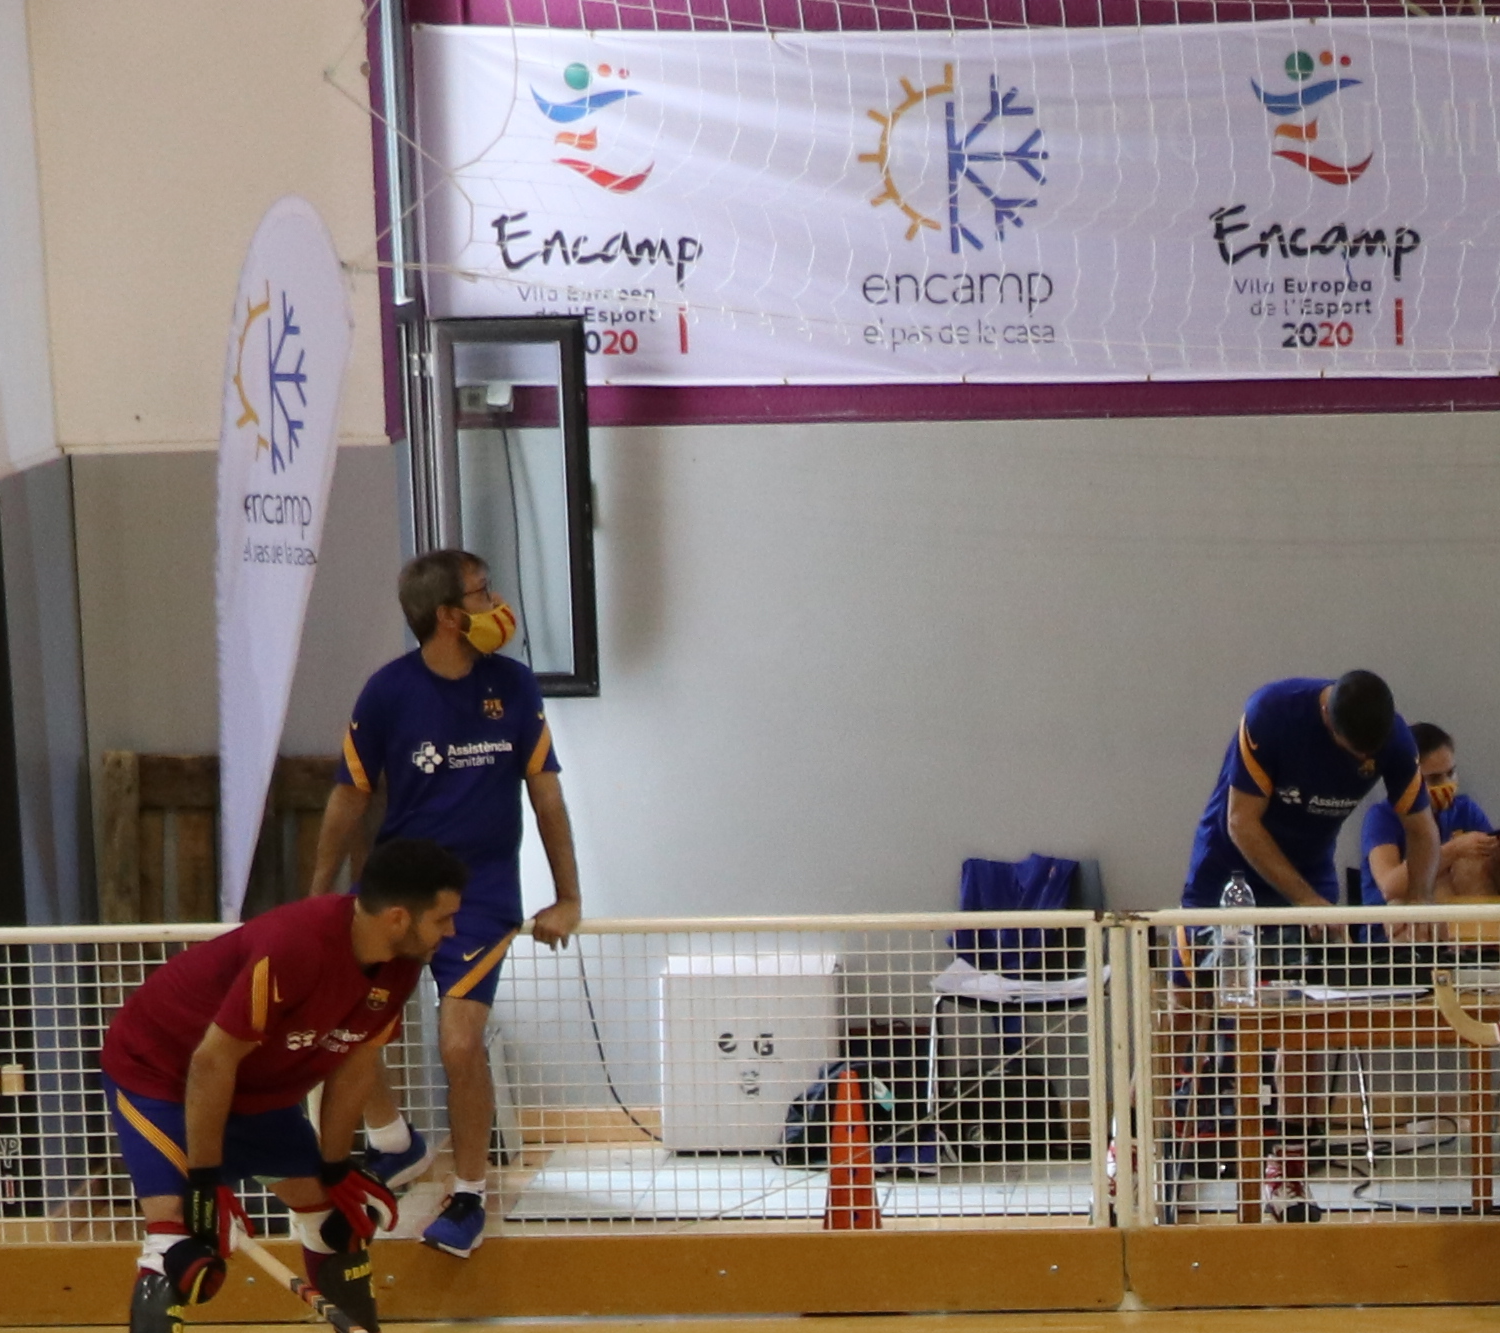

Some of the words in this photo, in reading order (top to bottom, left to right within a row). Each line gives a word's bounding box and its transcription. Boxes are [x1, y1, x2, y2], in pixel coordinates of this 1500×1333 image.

[491, 211, 704, 290] Encamp
[1208, 204, 1421, 282] Encamp
[862, 272, 1054, 318] encamp
[1234, 278, 1275, 295] Vila
[1284, 277, 1373, 295] Europea
[1250, 301, 1277, 317] de
[584, 328, 638, 355] 020
[892, 325, 934, 352] pas
[1002, 324, 1056, 345] casa
[1281, 321, 1355, 348] 2020
[447, 739, 513, 757] Assistència
